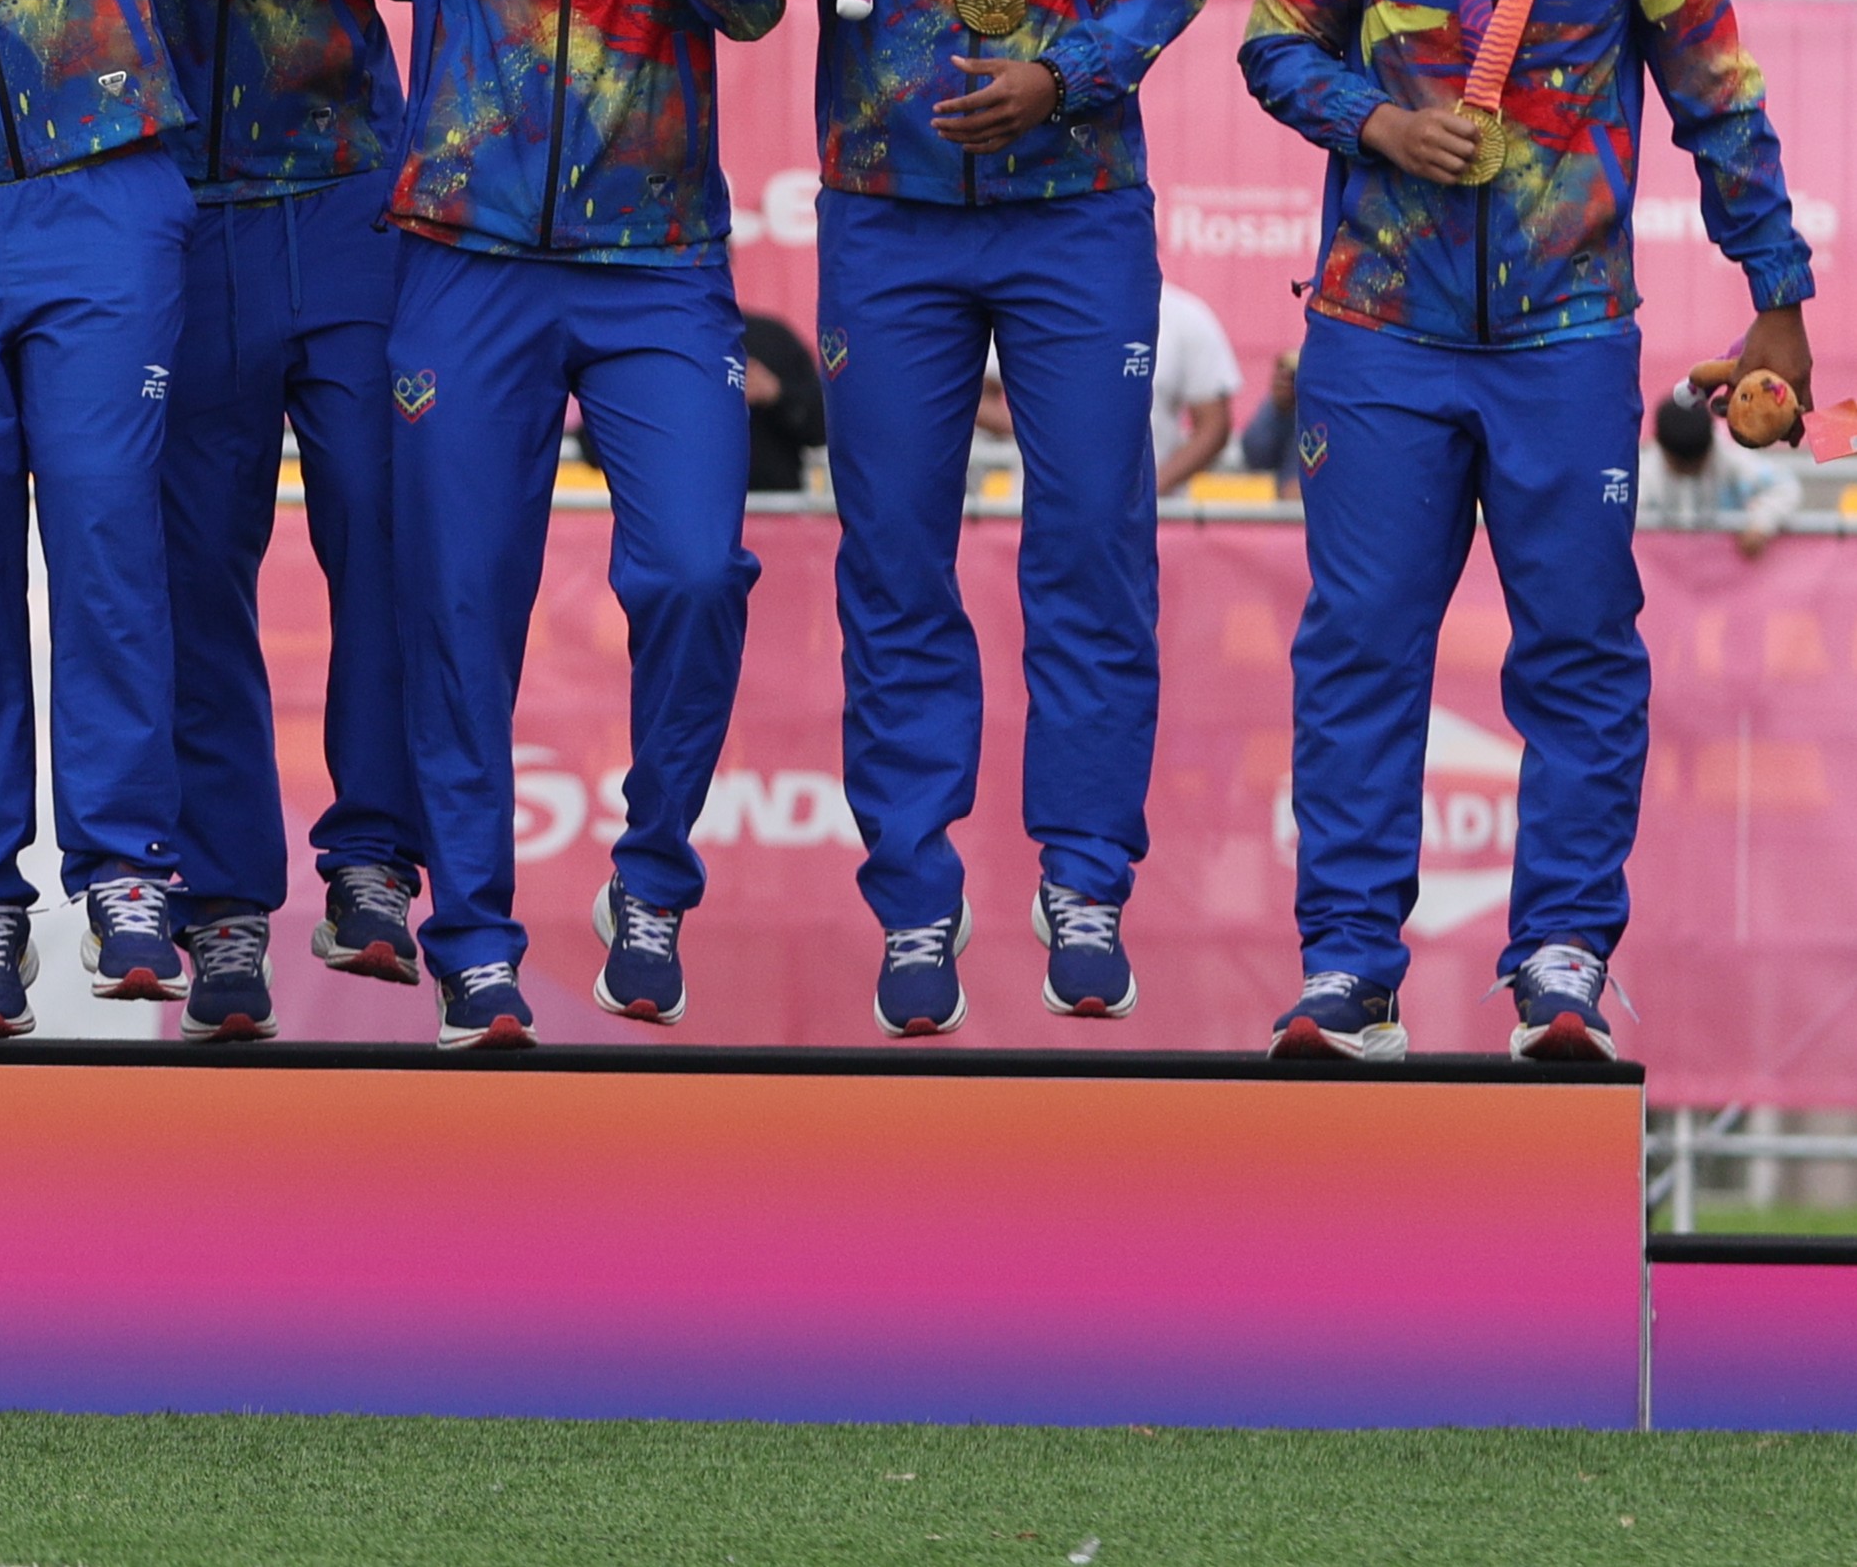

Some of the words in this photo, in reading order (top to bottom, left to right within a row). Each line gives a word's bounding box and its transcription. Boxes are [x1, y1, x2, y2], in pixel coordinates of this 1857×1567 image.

[1171, 204, 1324, 256] Rosari
[1123, 357, 1149, 376] RS
[142, 380, 166, 399] RS
[1603, 483, 1628, 503] RS
